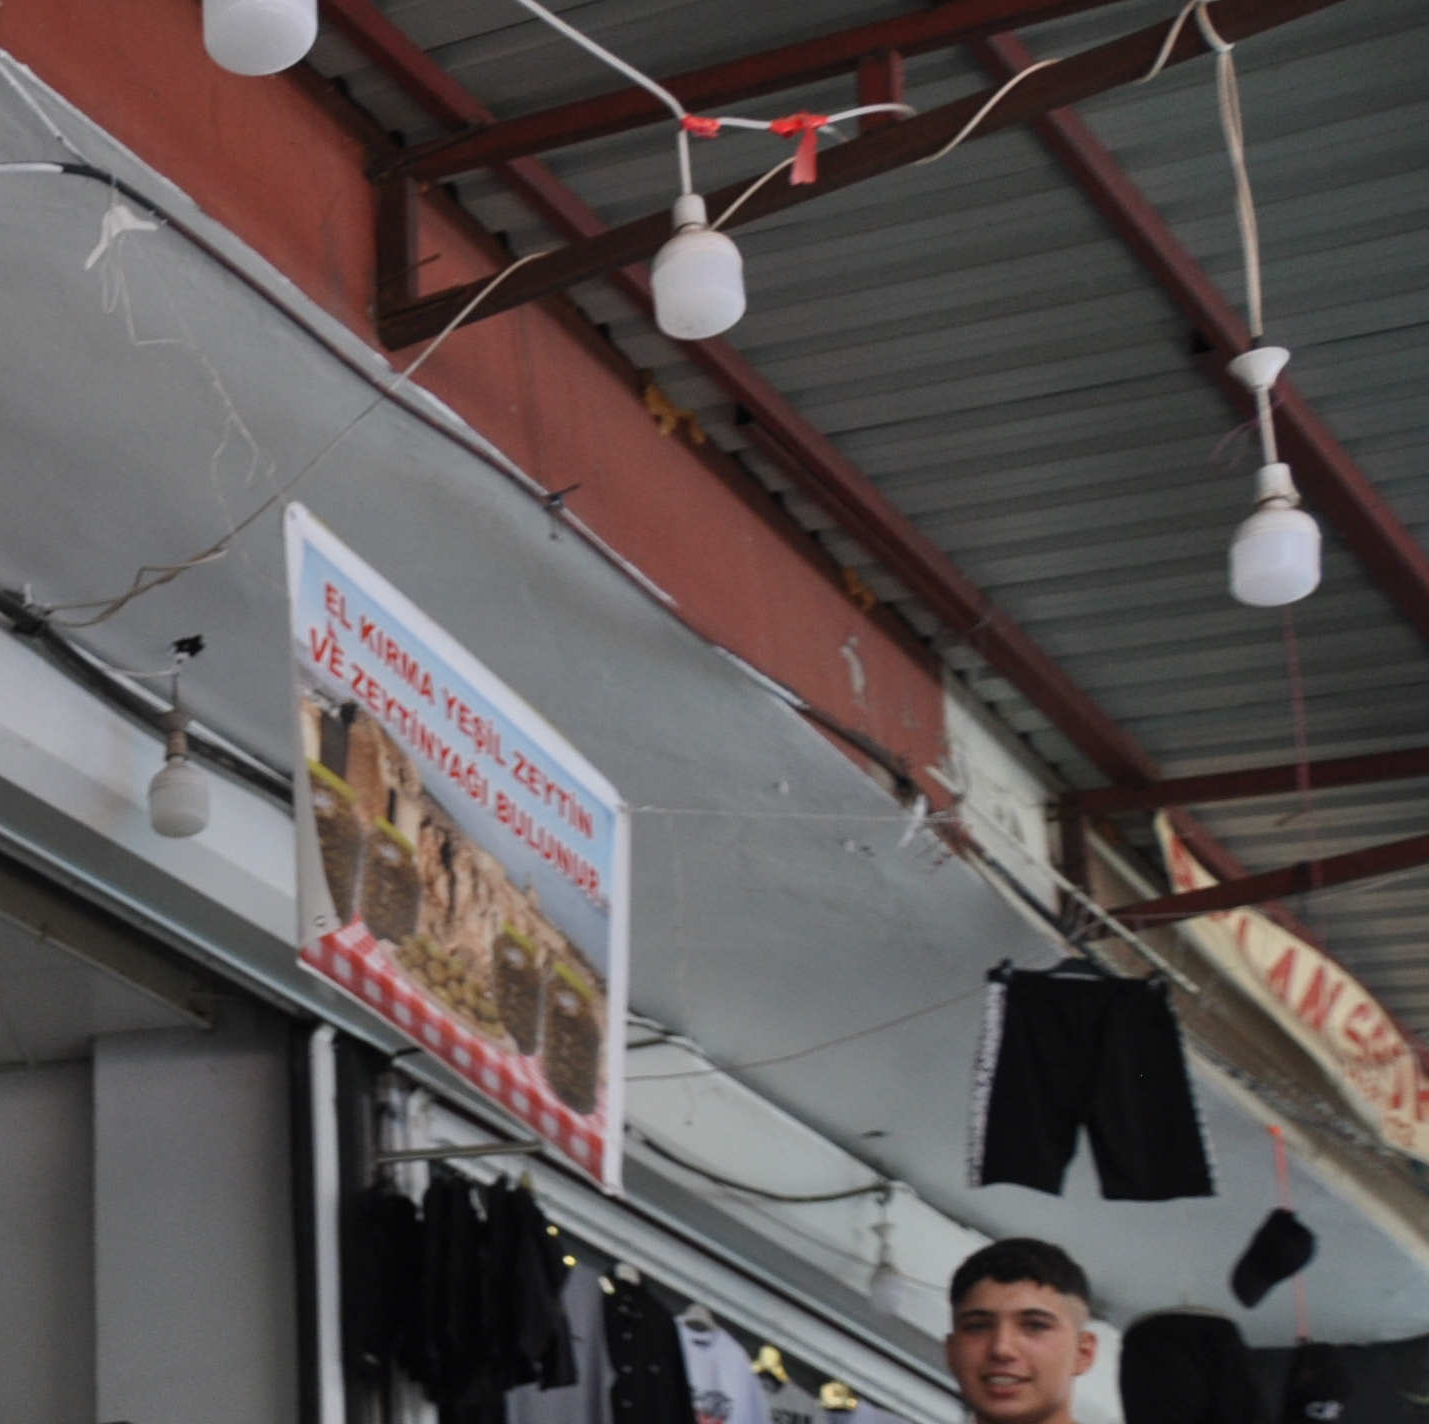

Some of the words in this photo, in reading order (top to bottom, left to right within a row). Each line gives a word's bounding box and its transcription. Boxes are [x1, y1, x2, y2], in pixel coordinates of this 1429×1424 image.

[309, 626, 345, 681] VE
[351, 662, 489, 808] ZEYTİNYAĞI
[494, 790, 602, 904] BULUNUR
[325, 582, 353, 630] EL
[359, 614, 435, 704] KIRMA
[442, 686, 506, 767] YEŞİL
[512, 749, 593, 840] ZEYTİN
